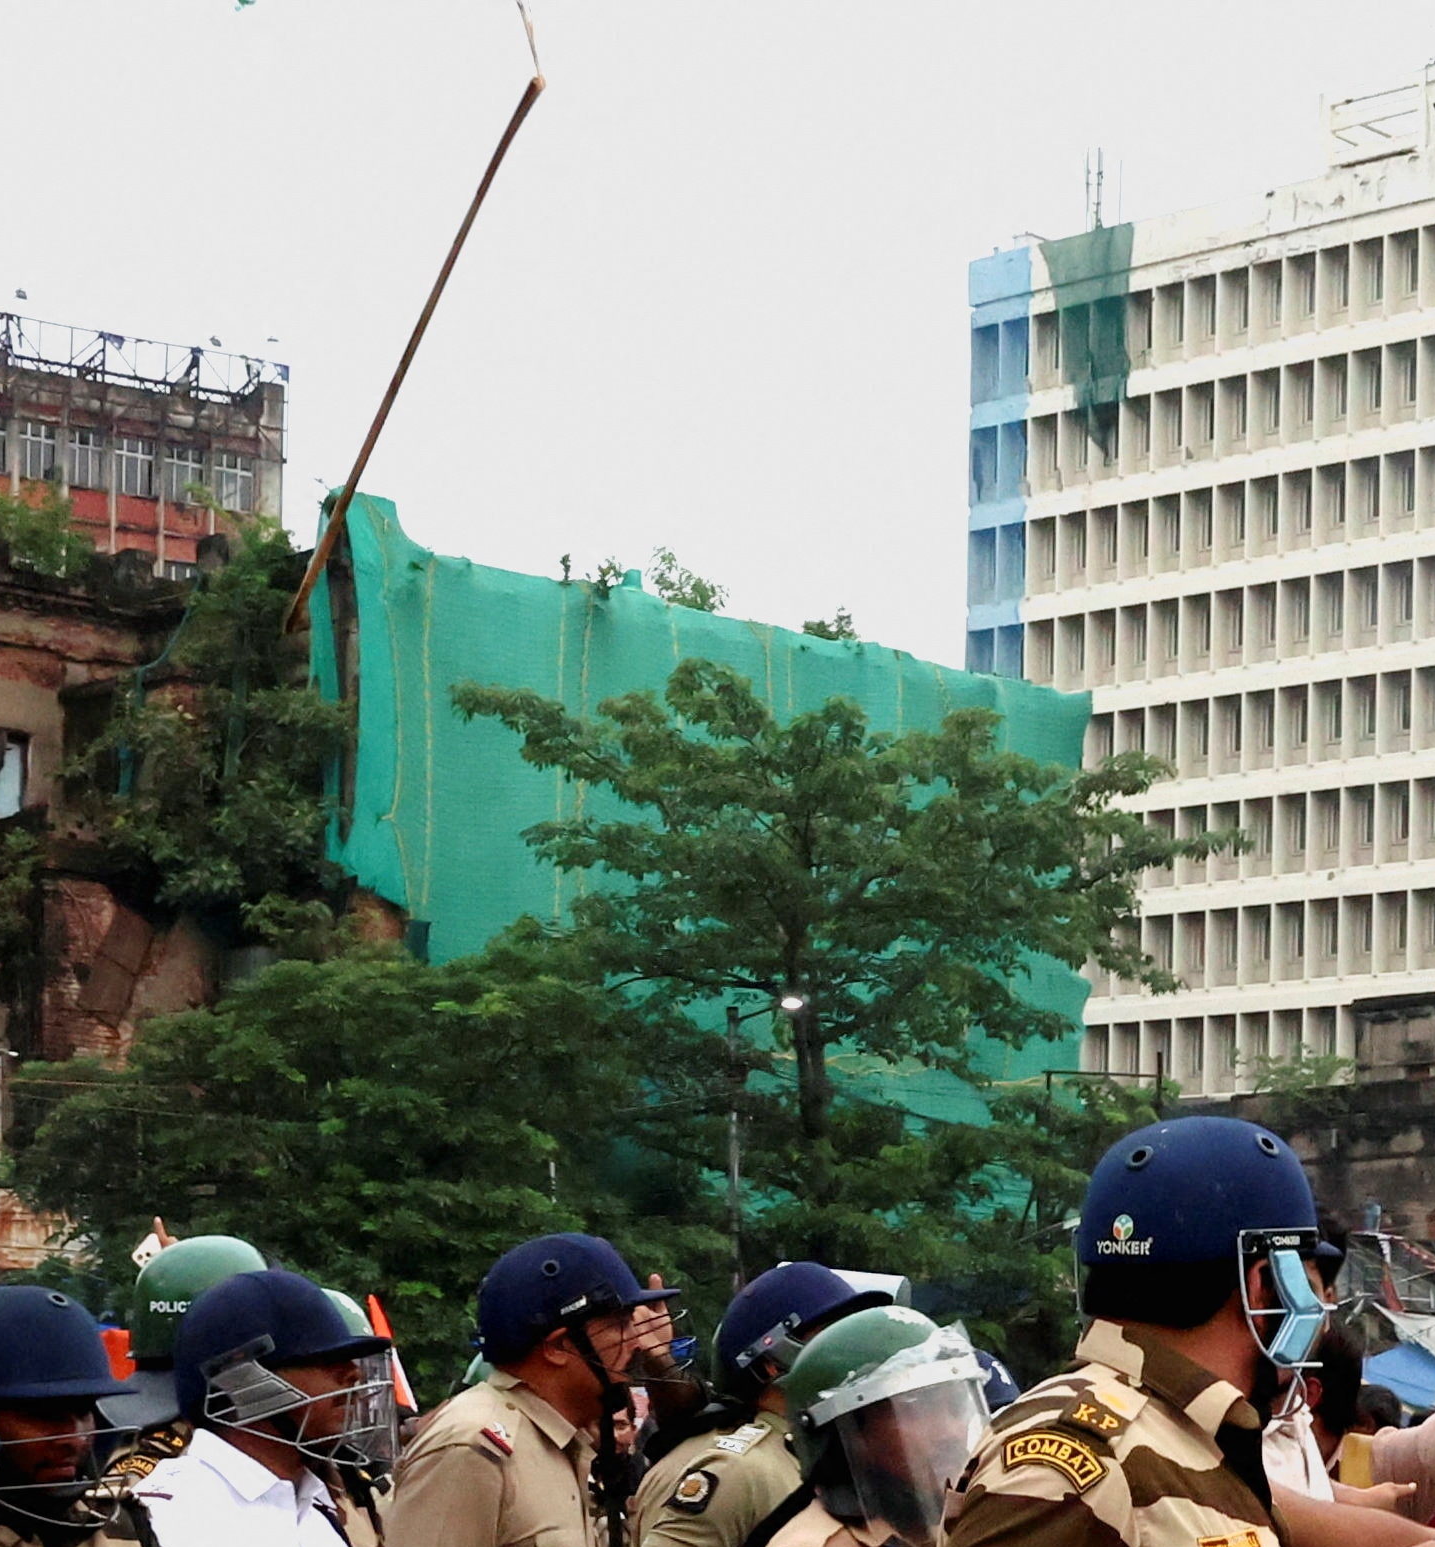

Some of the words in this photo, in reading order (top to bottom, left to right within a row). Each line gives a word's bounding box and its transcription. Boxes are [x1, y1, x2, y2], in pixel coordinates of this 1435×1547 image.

[1097, 1240, 1152, 1255] YONKER
[150, 1300, 191, 1313] POLIC
[1013, 1439, 1096, 1476] COMBAT
[120, 1459, 154, 1473] COMB
